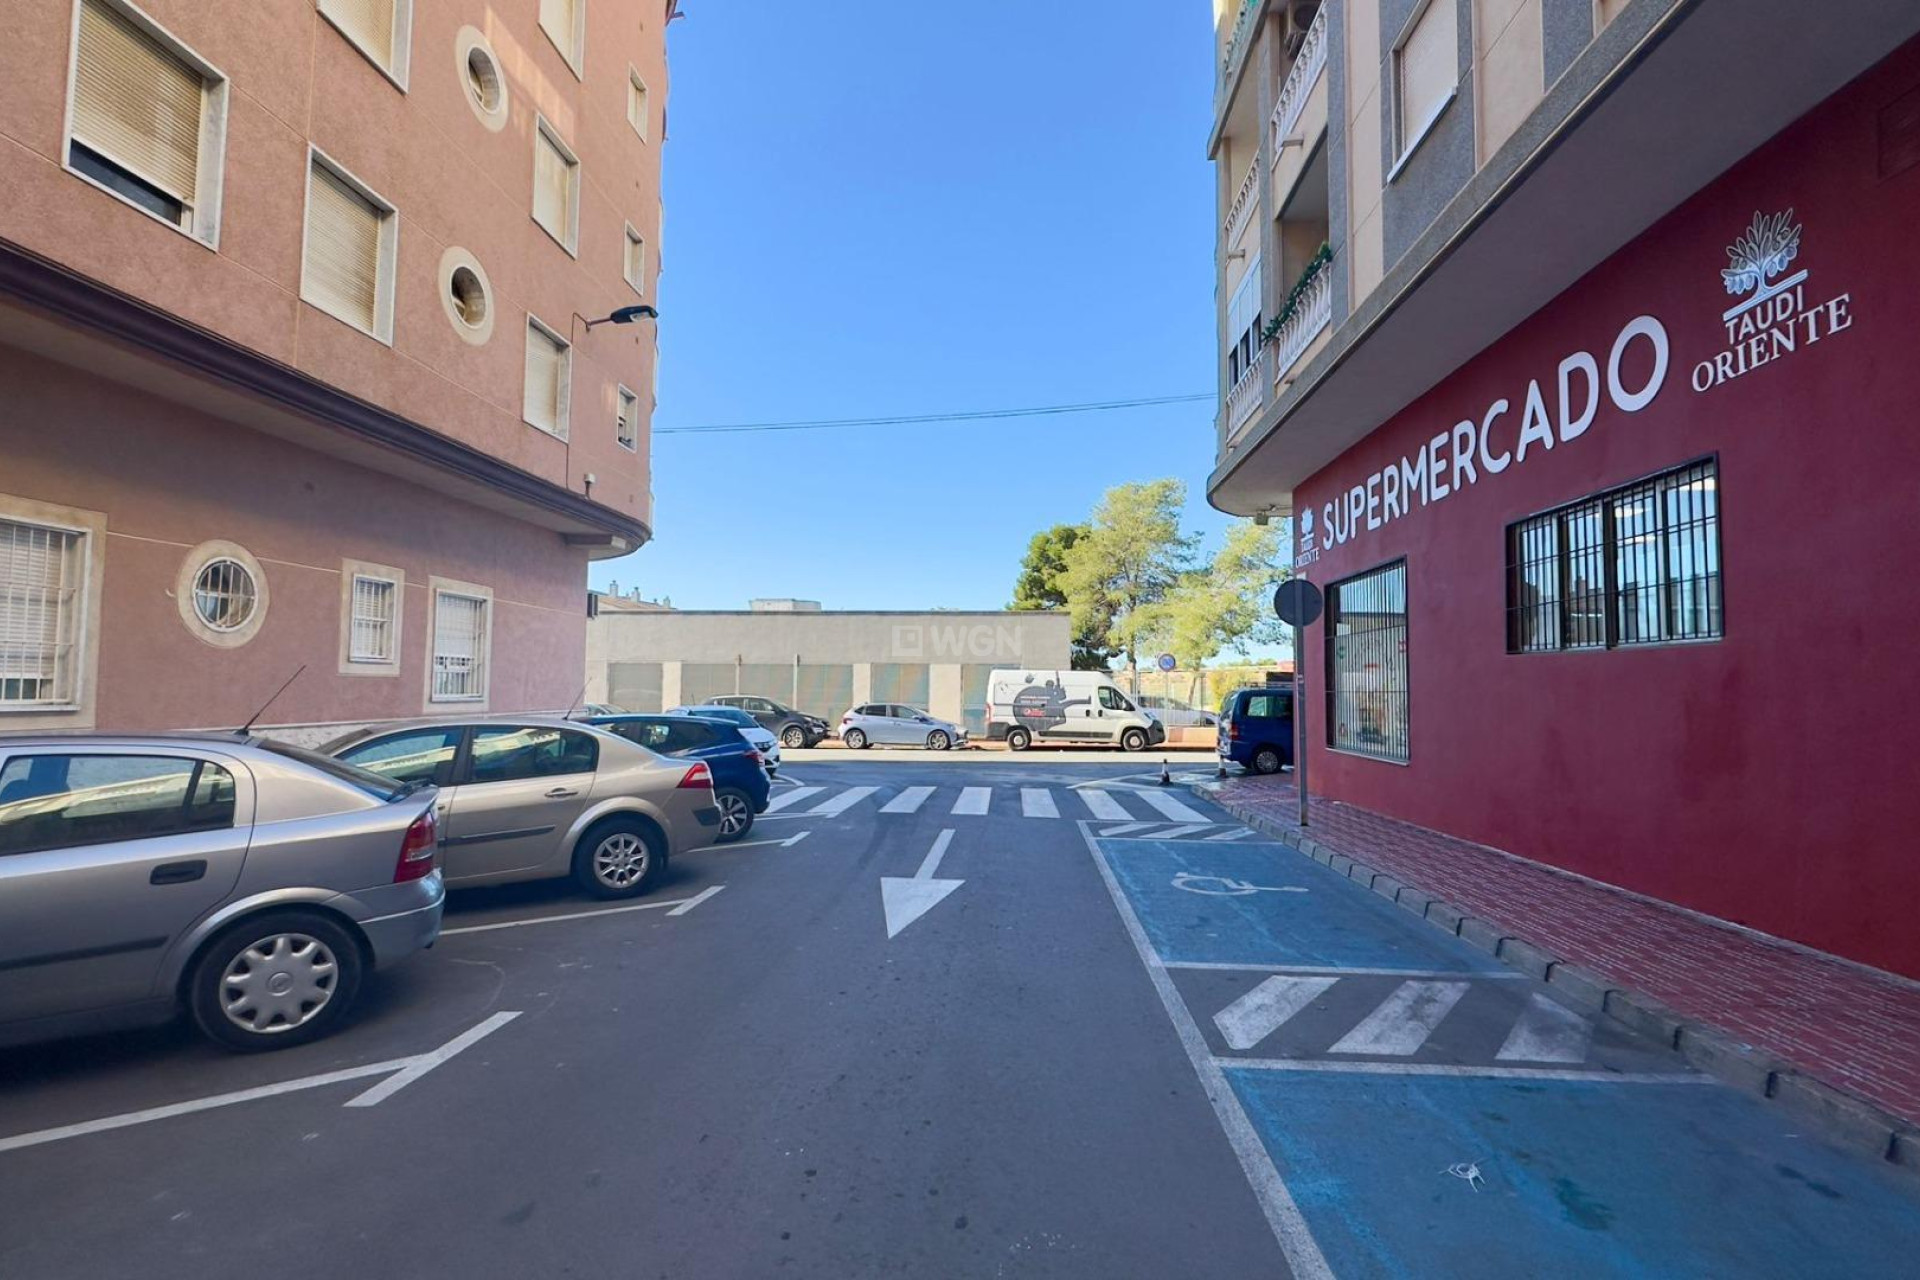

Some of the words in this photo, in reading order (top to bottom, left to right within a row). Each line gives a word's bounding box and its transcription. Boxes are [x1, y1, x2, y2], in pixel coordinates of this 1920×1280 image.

[1692, 293, 1854, 393] ORIENTE
[1725, 285, 1803, 345] TAUDI
[1322, 314, 1670, 551] SUPERMERCADO
